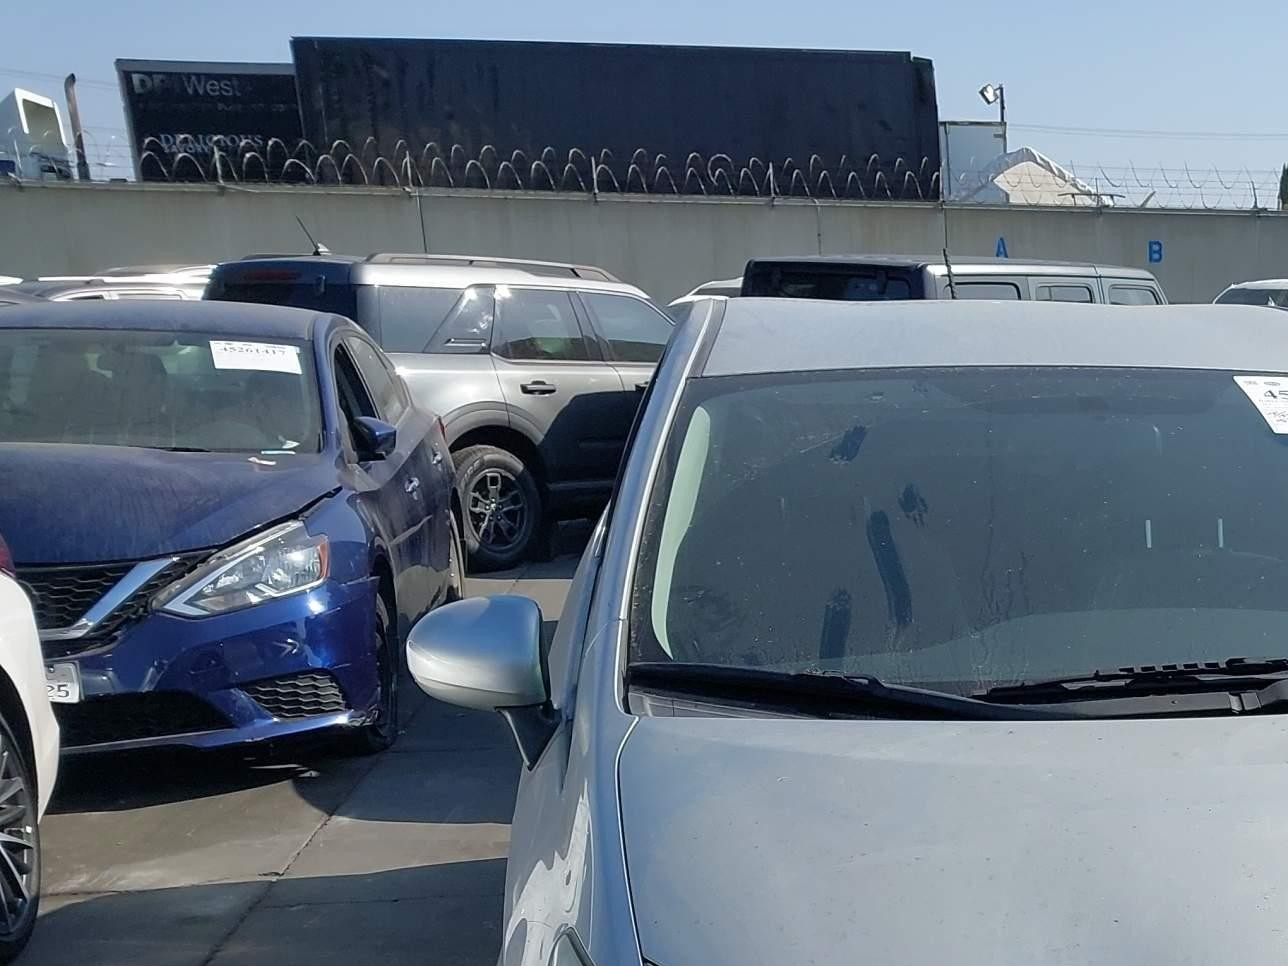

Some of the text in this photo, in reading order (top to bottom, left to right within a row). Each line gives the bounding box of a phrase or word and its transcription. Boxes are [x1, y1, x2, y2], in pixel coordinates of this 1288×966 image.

[182, 74, 242, 97] West
[995, 236, 1009, 259] A
[1148, 240, 1164, 263] B
